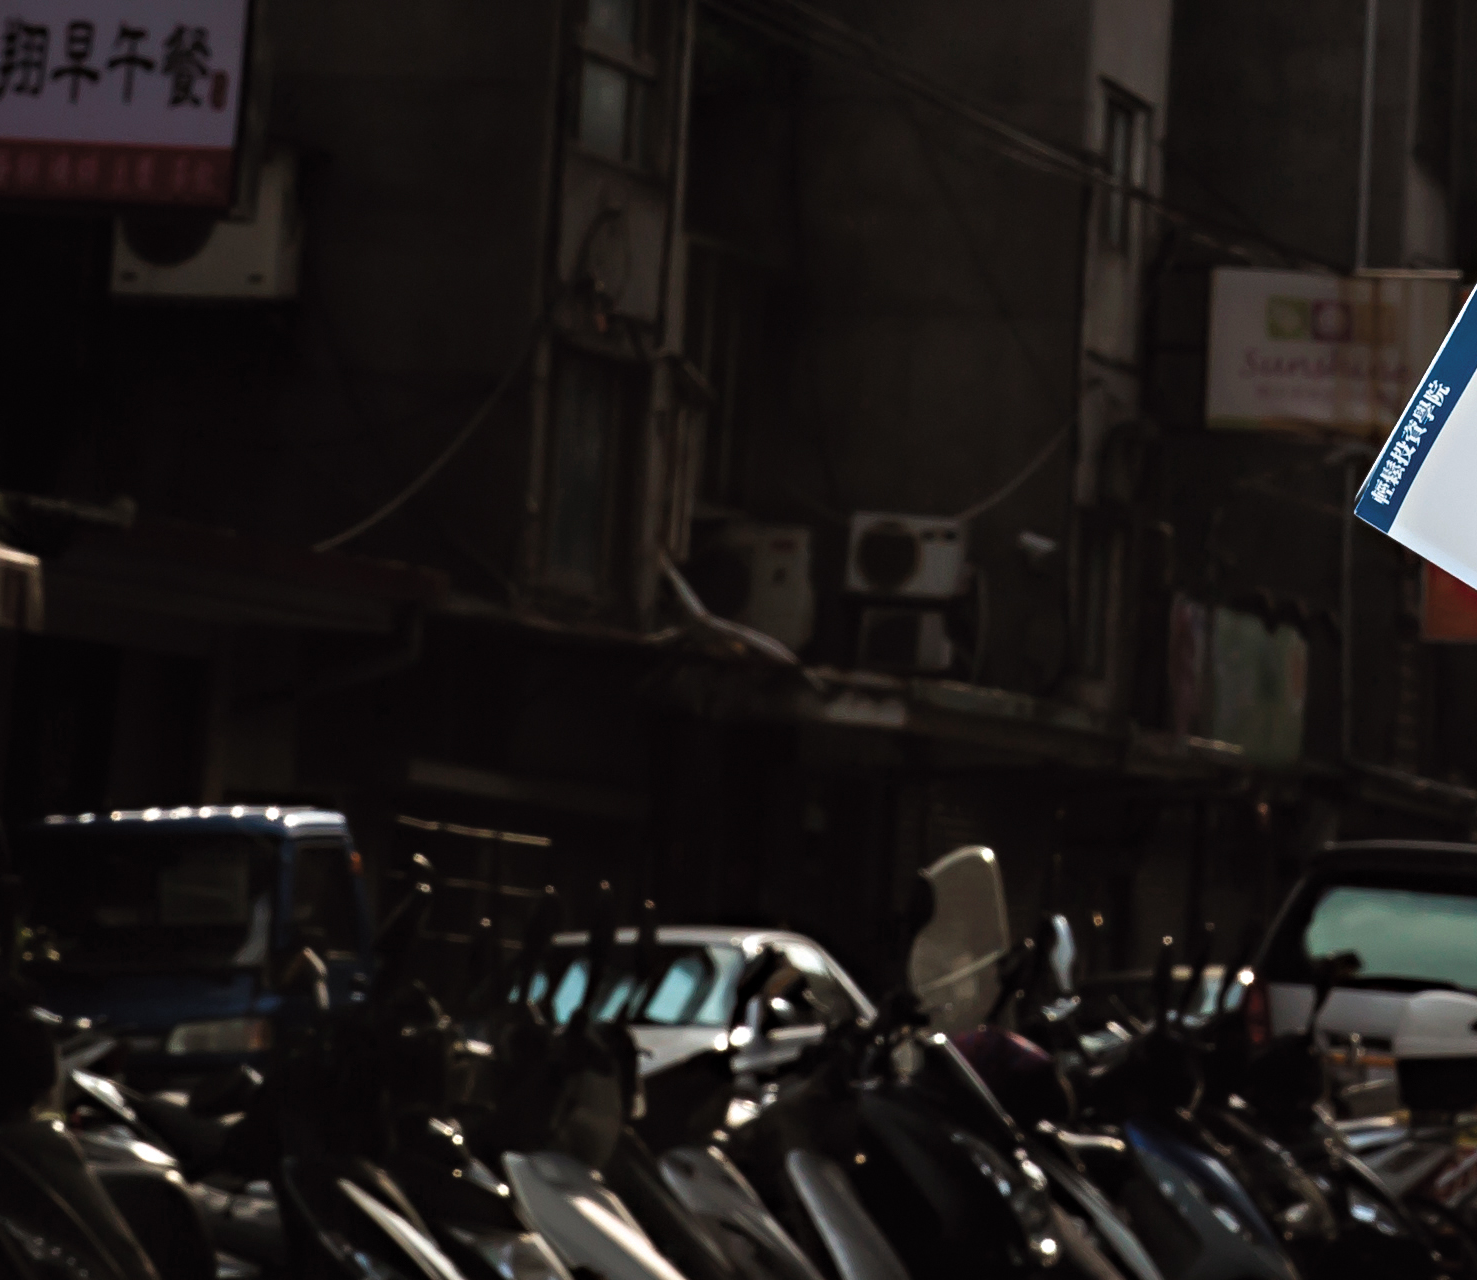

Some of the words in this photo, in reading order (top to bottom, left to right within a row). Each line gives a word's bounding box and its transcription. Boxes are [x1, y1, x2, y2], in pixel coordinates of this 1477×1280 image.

[1370, 379, 1451, 506] 輕鬆投資學院
